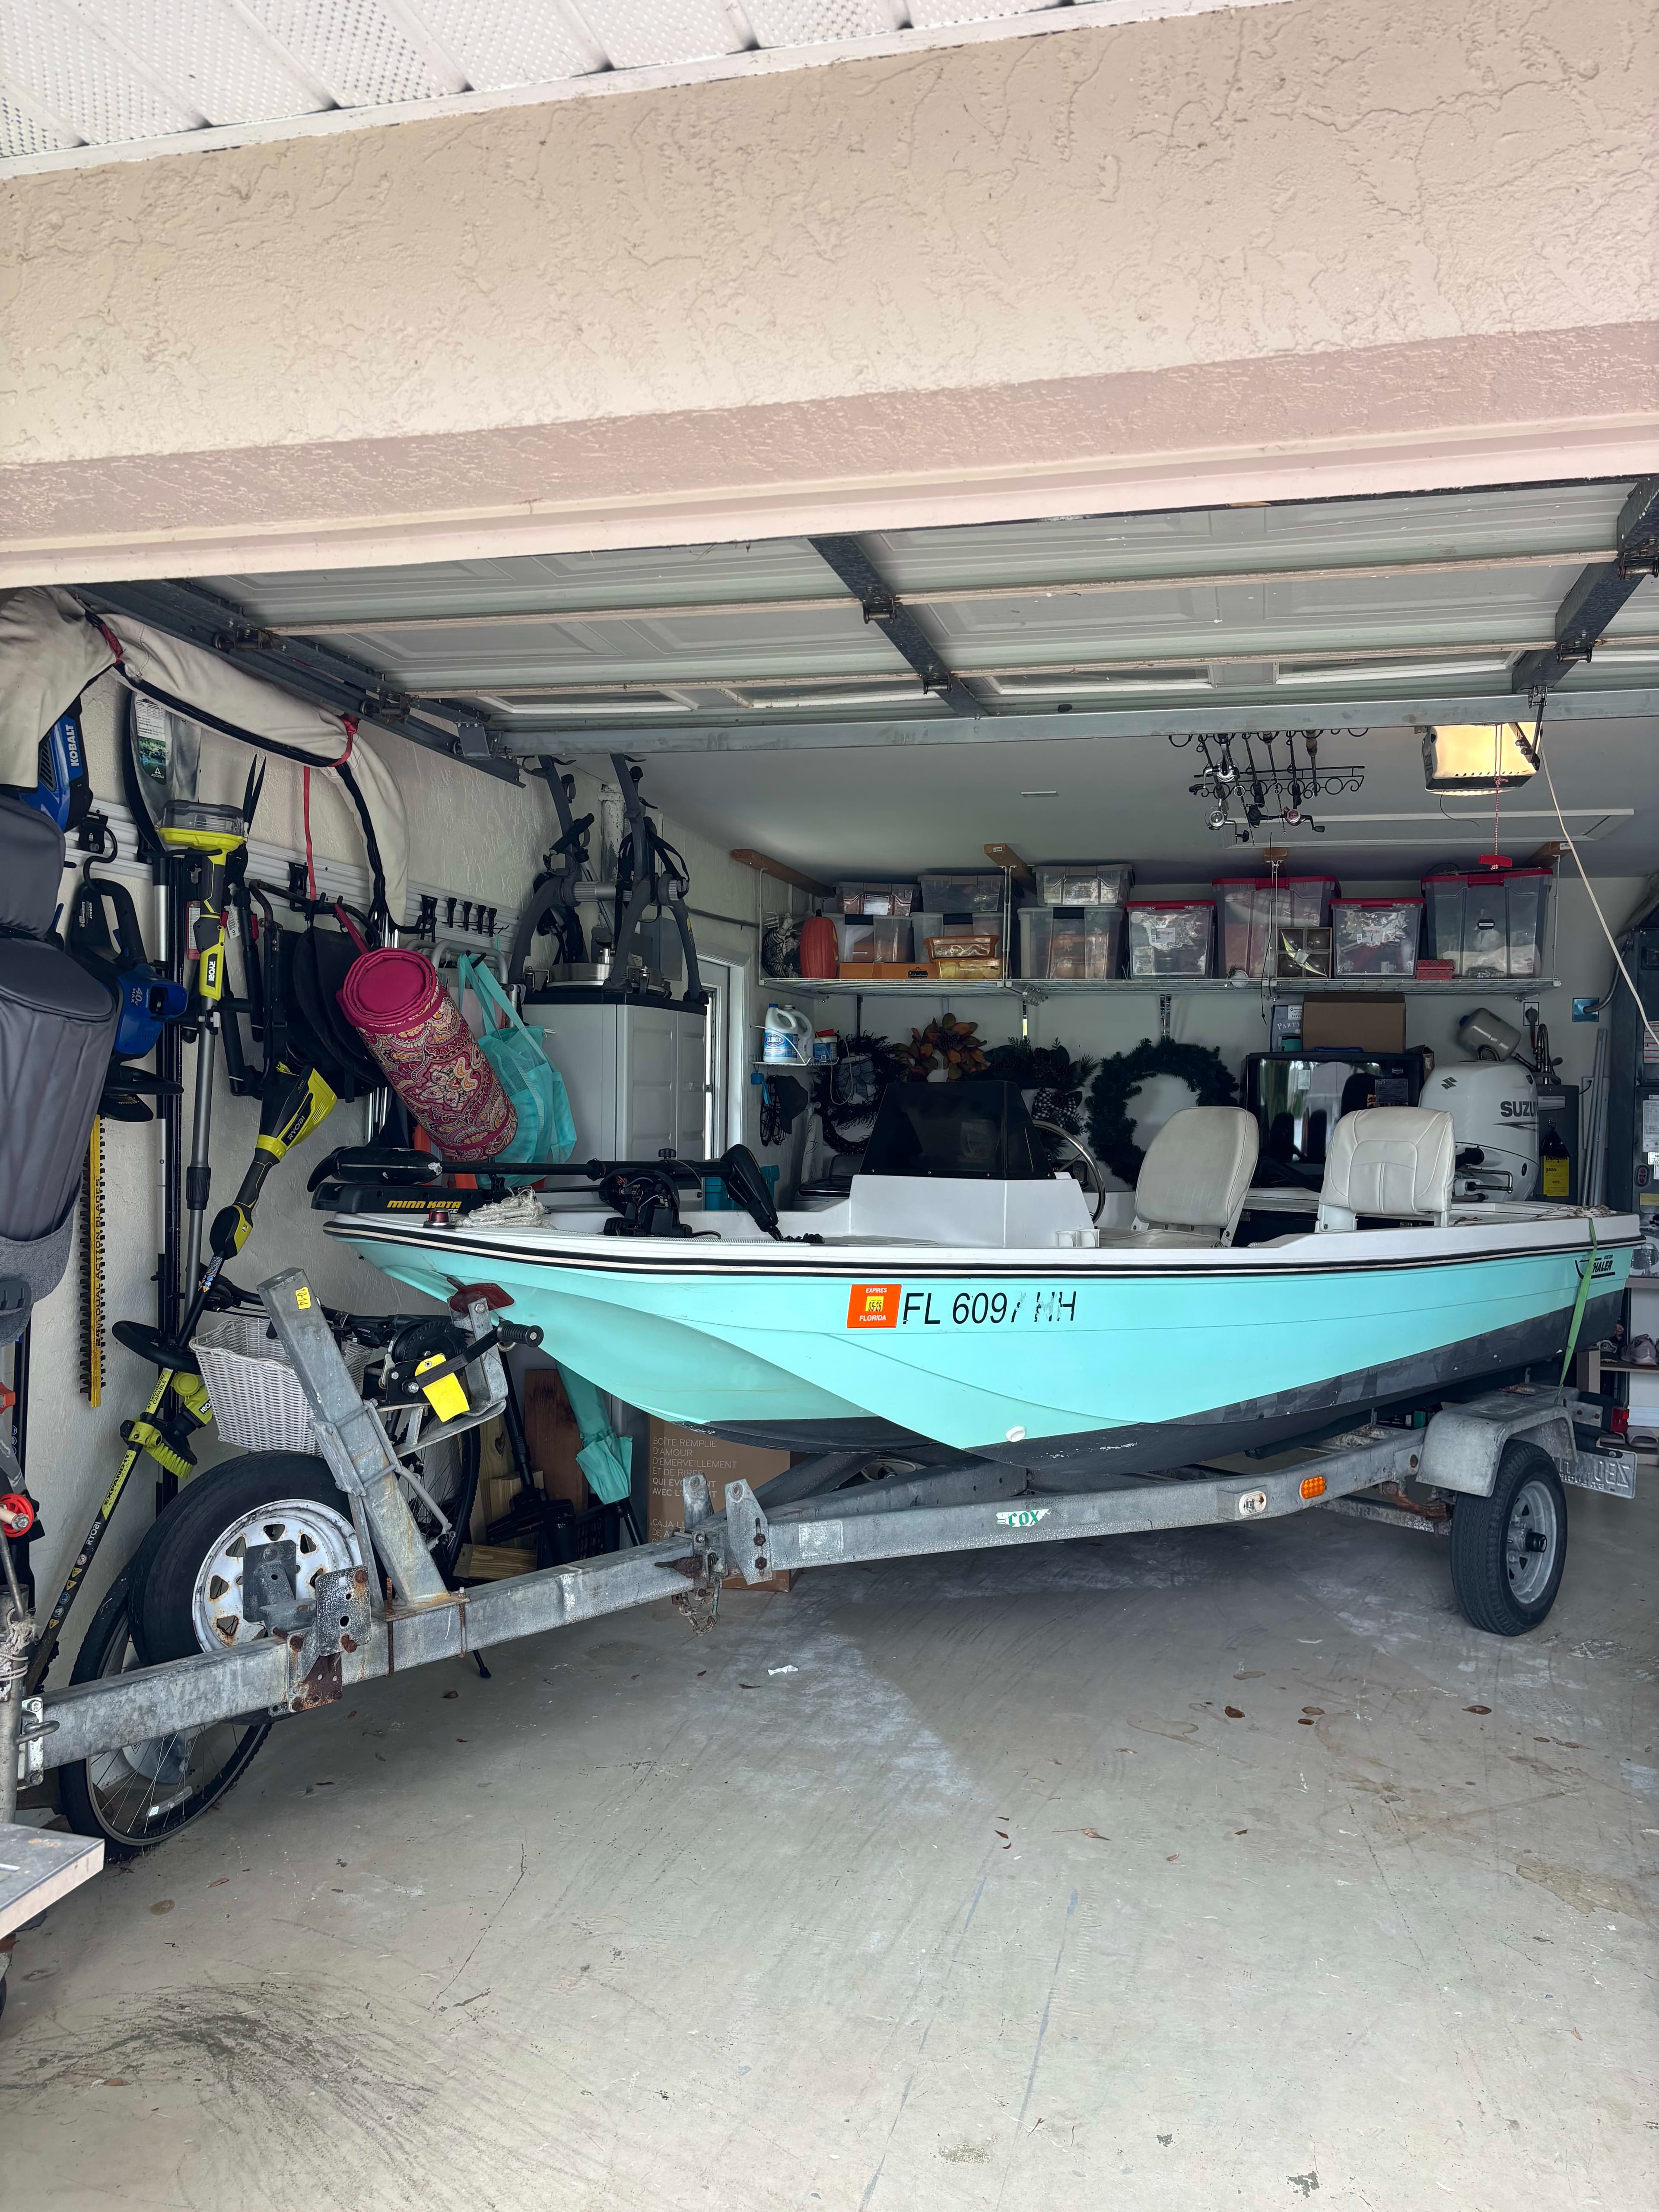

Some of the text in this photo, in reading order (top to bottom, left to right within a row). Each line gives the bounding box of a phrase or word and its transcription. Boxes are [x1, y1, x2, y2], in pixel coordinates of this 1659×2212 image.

[66, 725, 79, 766] KOBALT
[287, 1116, 305, 1140] RYOBI
[1592, 1260, 1613, 1273] HALER
[868, 1301, 882, 1312] 05-26
[903, 1293, 941, 1325] FL
[147, 1374, 165, 1409] ATTACHMENT
[153, 1379, 166, 1404] CAPABLE
[200, 1401, 211, 1413] OBI
[653, 1437, 717, 1447] BOÎTE REMPLIE
[653, 1447, 693, 1456] D'AMOUR
[653, 1457, 737, 1468] D'ÉMERVEILLEMENT
[104, 1453, 130, 1505] EXPAND-IT
[653, 1478, 665, 1486] QUI
[652, 1487, 672, 1496] AVEC
[652, 1518, 674, 1528] CAJA
[86, 1522, 101, 1545] RYOBI
[652, 1528, 662, 1537] DE
